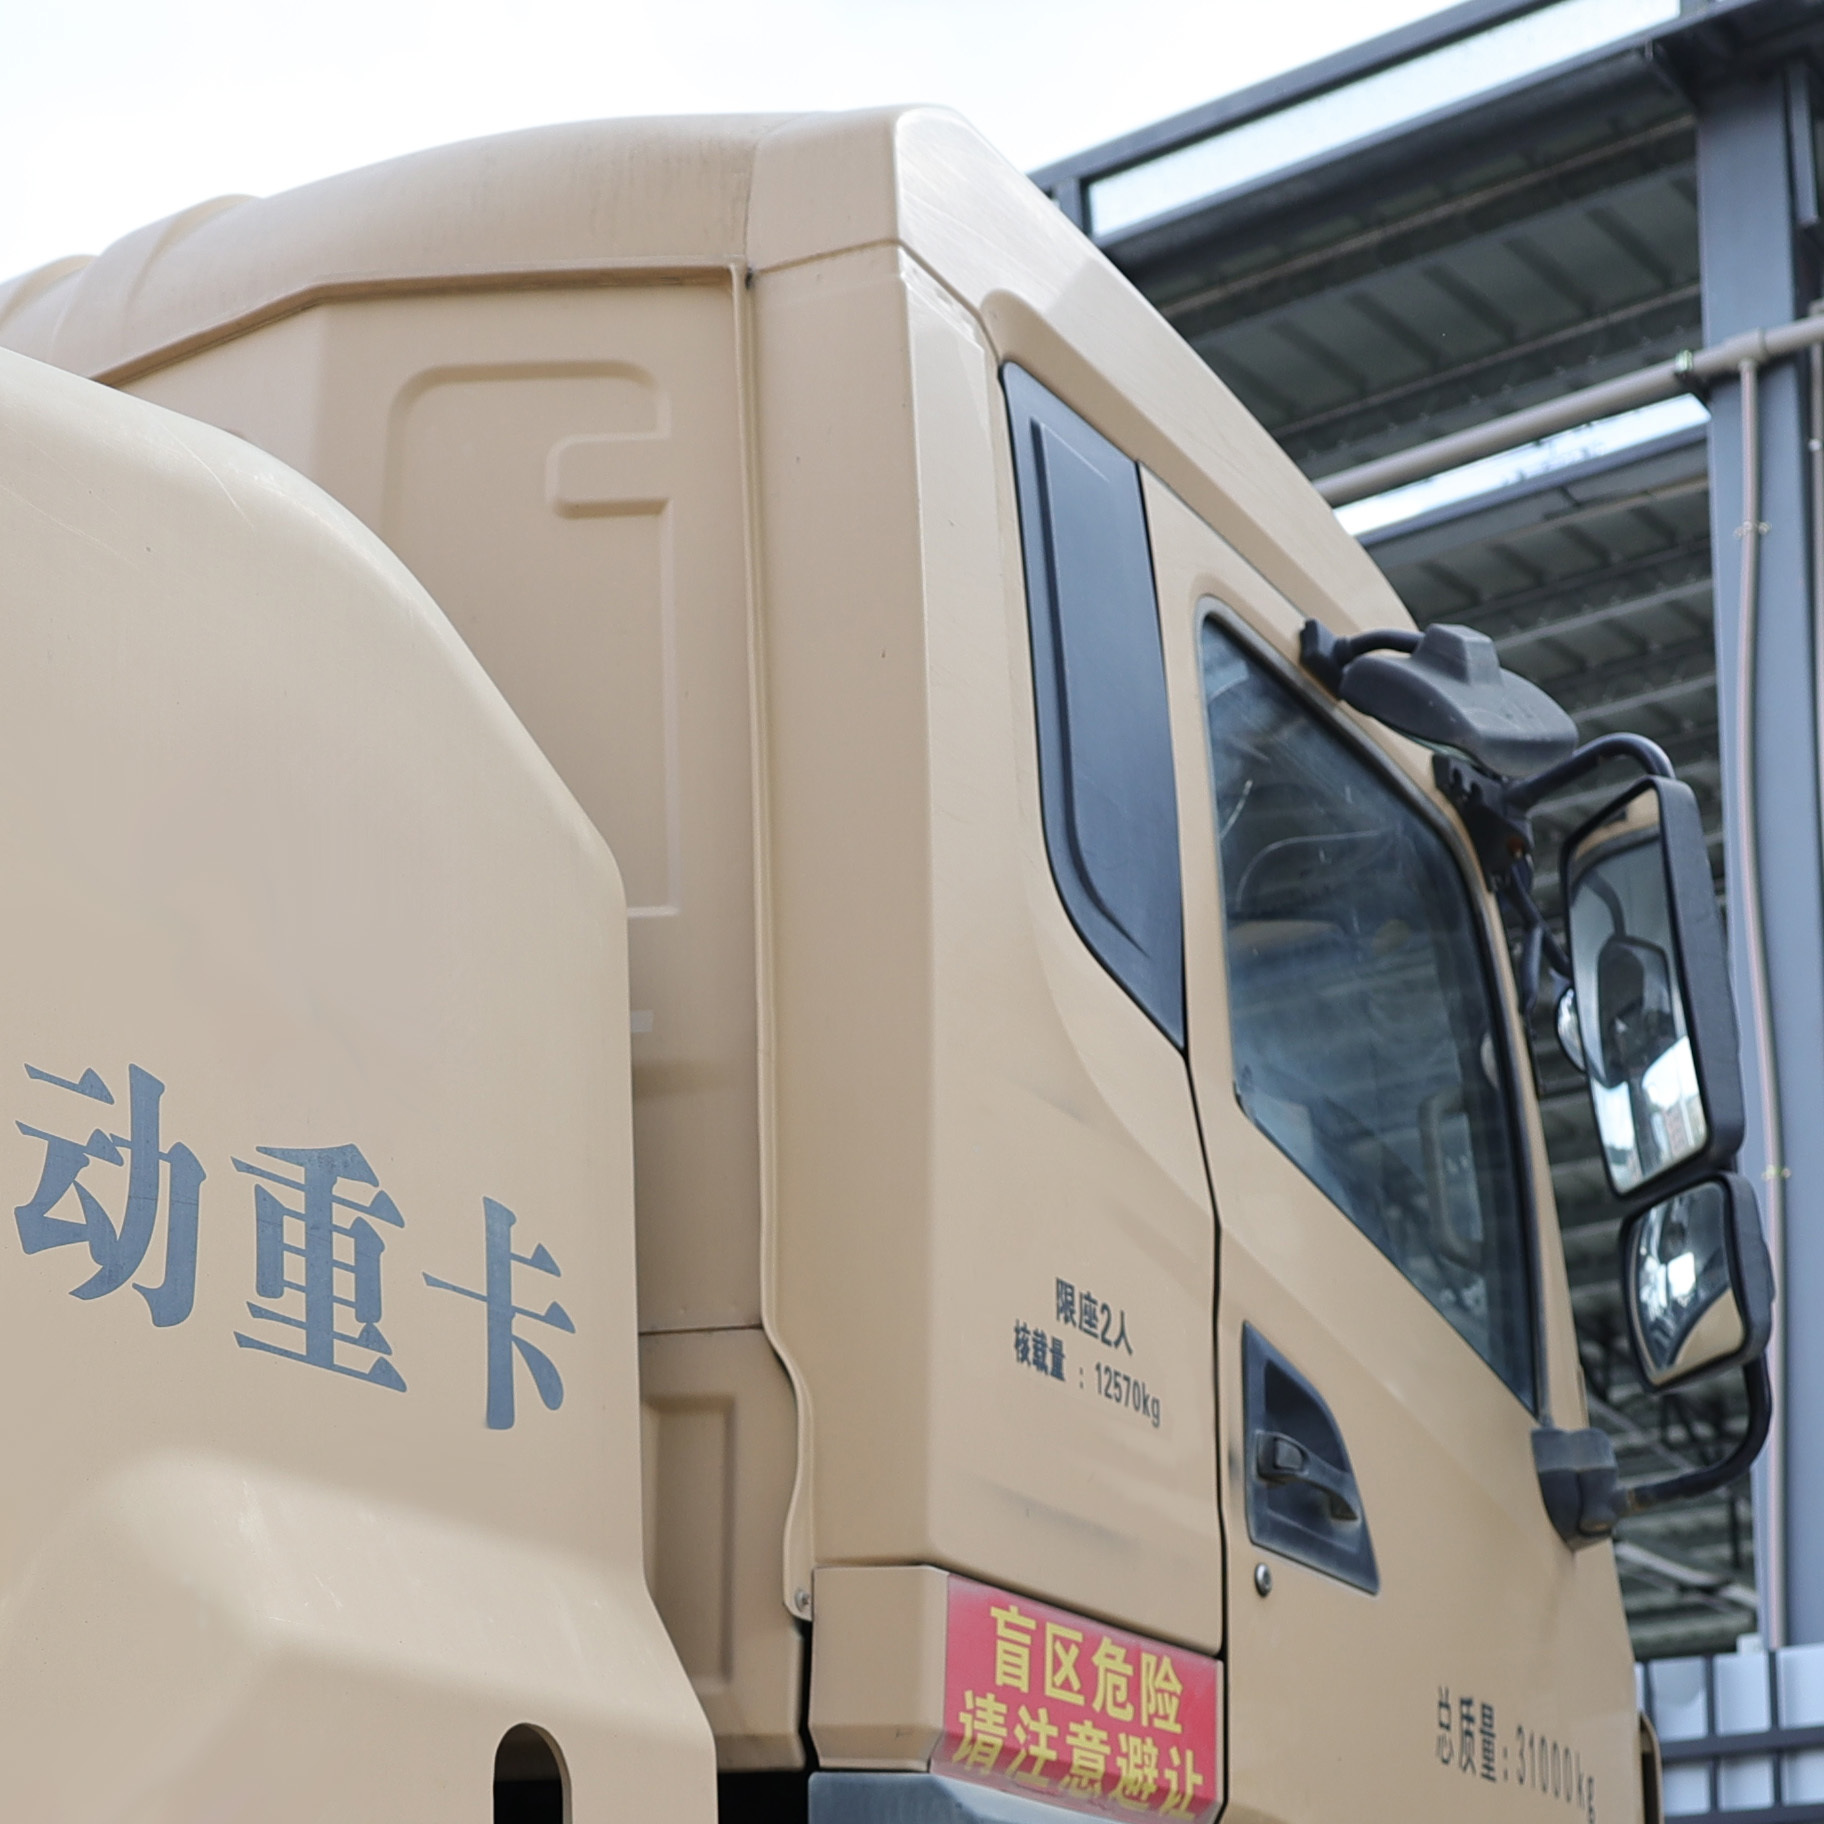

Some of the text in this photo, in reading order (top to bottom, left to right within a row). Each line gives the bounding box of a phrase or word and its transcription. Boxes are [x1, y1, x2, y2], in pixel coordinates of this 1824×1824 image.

[1056, 1277, 1133, 1356] 限座2人
[990, 1605, 1183, 1734] 盲区危险
[952, 1690, 1203, 1821] 请注意避让
